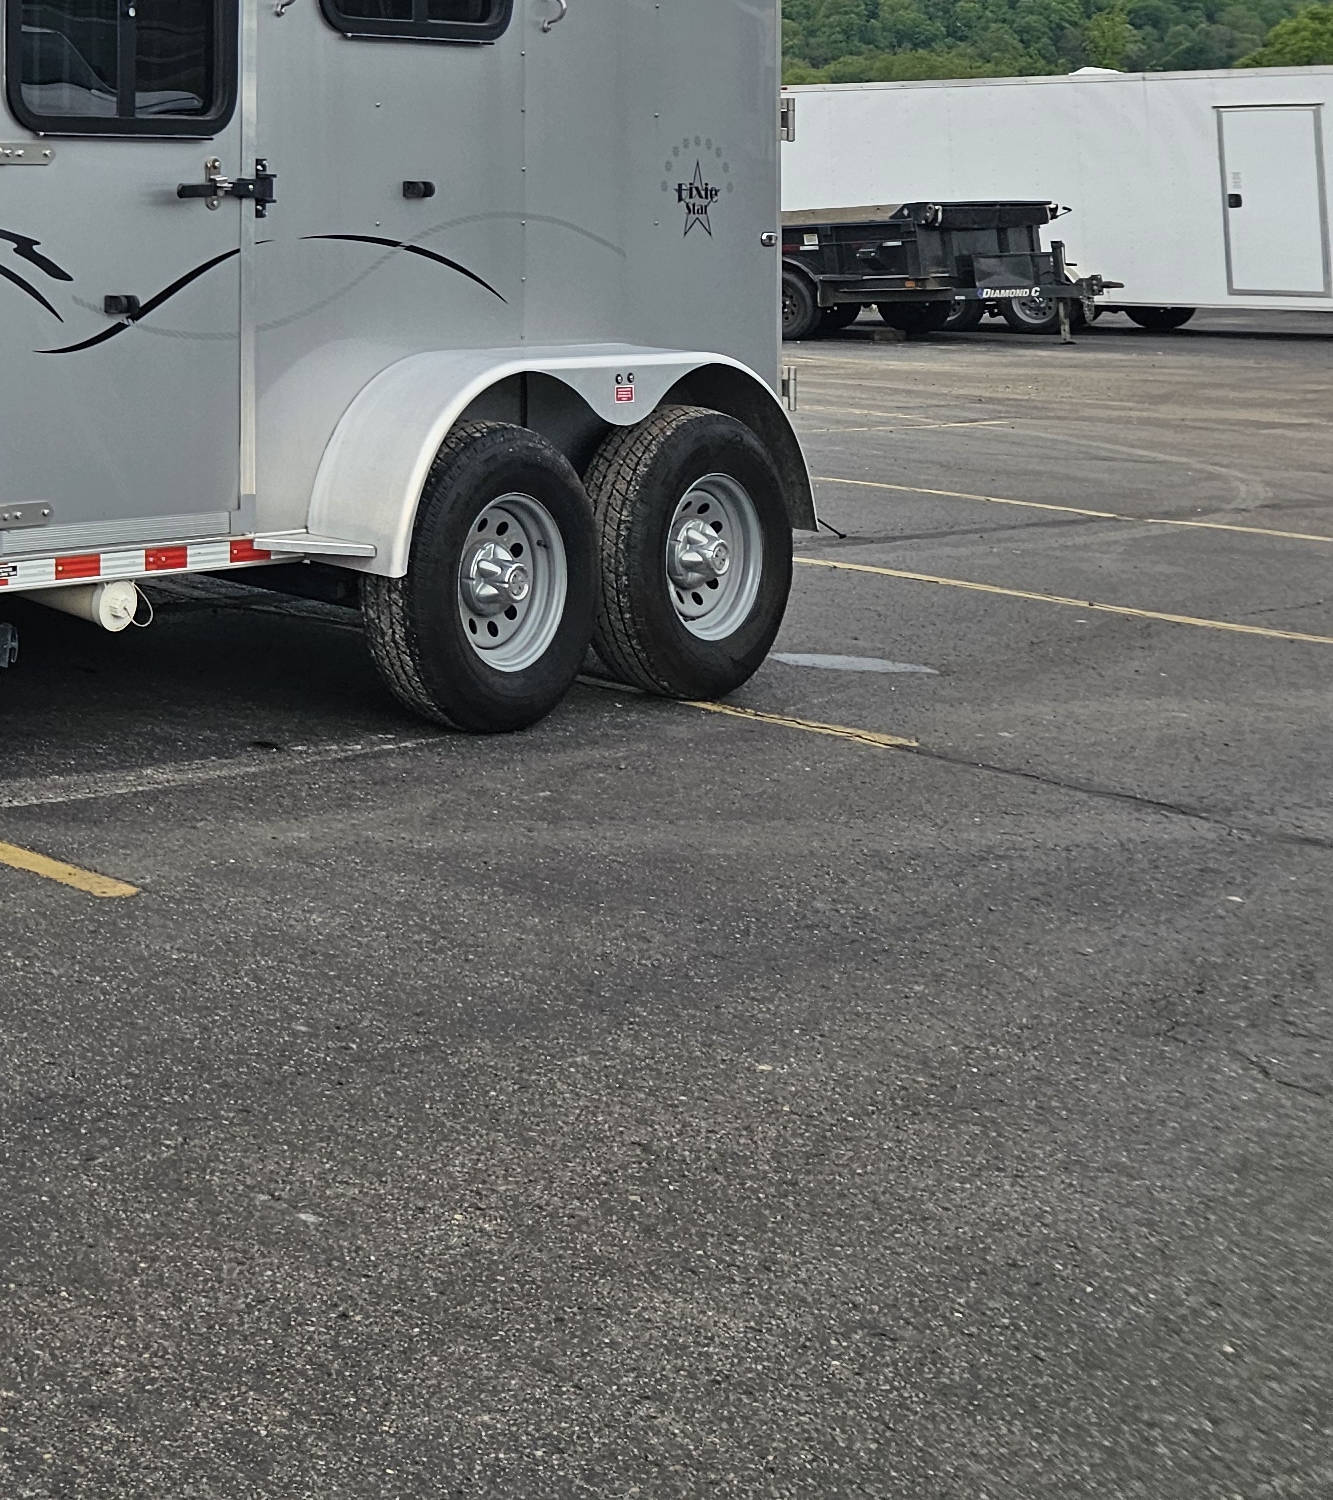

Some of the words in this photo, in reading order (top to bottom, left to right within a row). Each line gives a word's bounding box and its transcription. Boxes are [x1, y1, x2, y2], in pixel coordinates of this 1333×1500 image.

[678, 183, 718, 203] Dixie
[685, 202, 708, 215] Star
[982, 288, 1030, 298] DIAMOND
[1031, 287, 1040, 297] C
